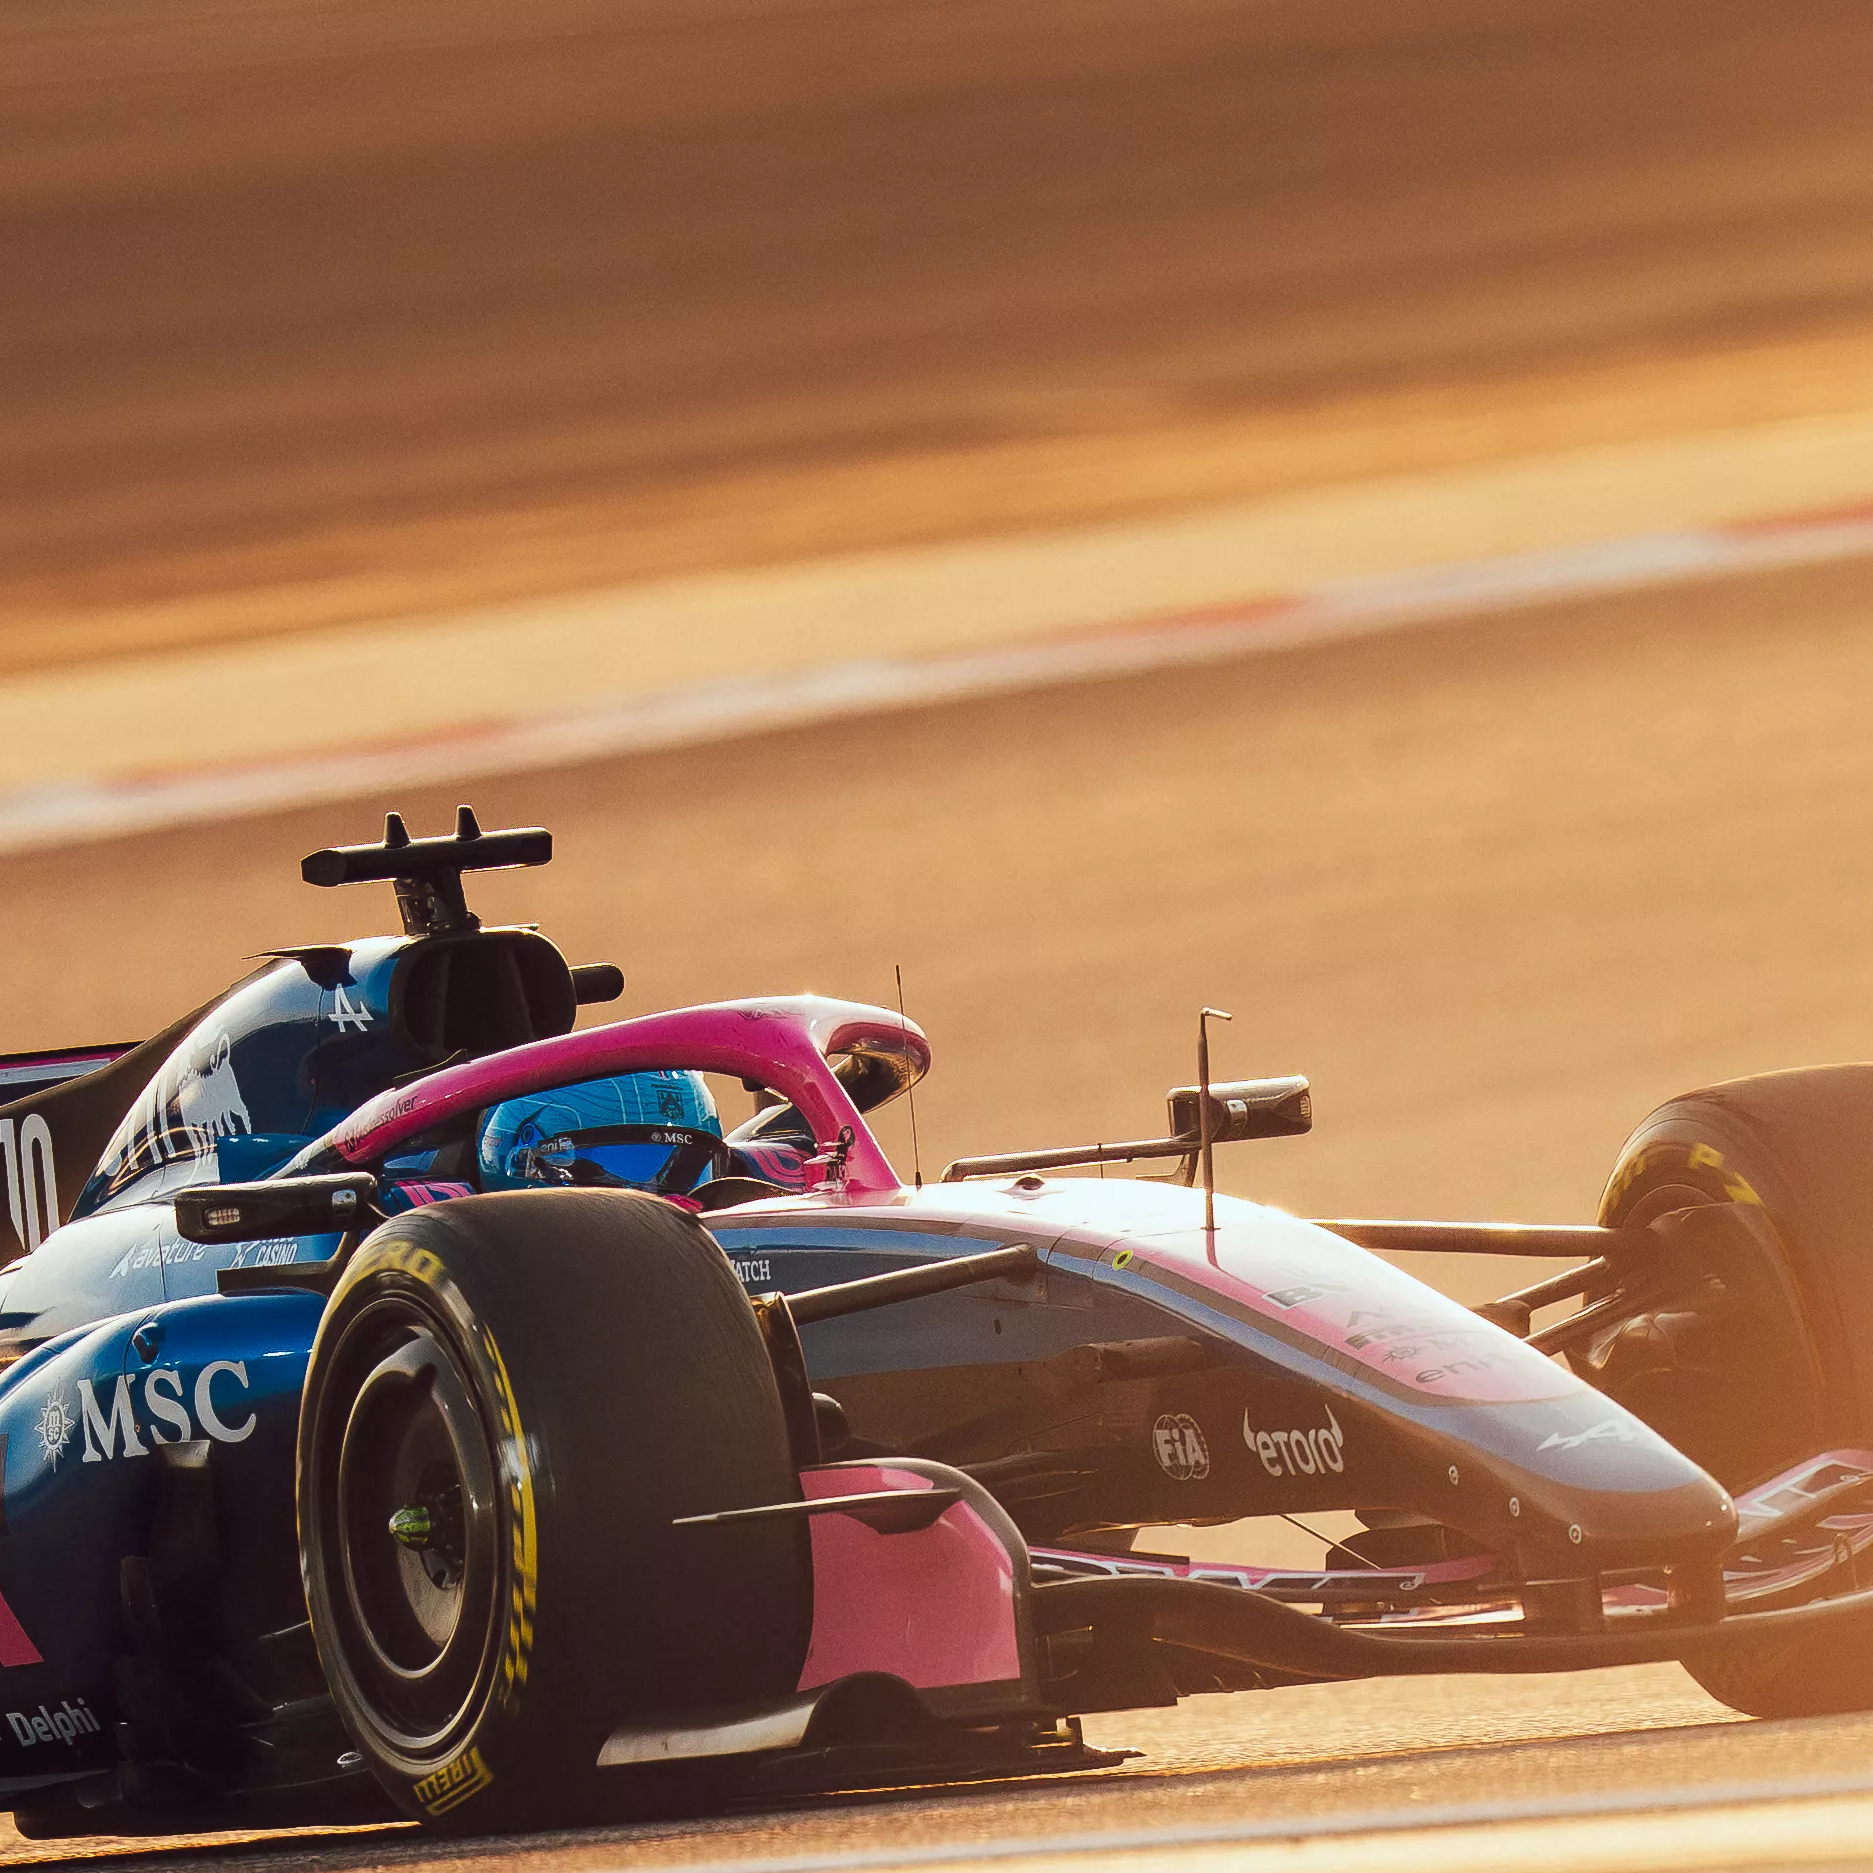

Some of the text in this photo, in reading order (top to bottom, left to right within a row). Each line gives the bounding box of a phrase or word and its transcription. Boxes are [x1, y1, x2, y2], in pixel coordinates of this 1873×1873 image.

[664, 1132, 693, 1145] MSC
[132, 1237, 207, 1269] avature
[256, 1243, 298, 1267] CASINO
[730, 1260, 772, 1283] ATCH
[77, 1361, 257, 1463] MSC
[6, 1697, 101, 1746] Delphi
